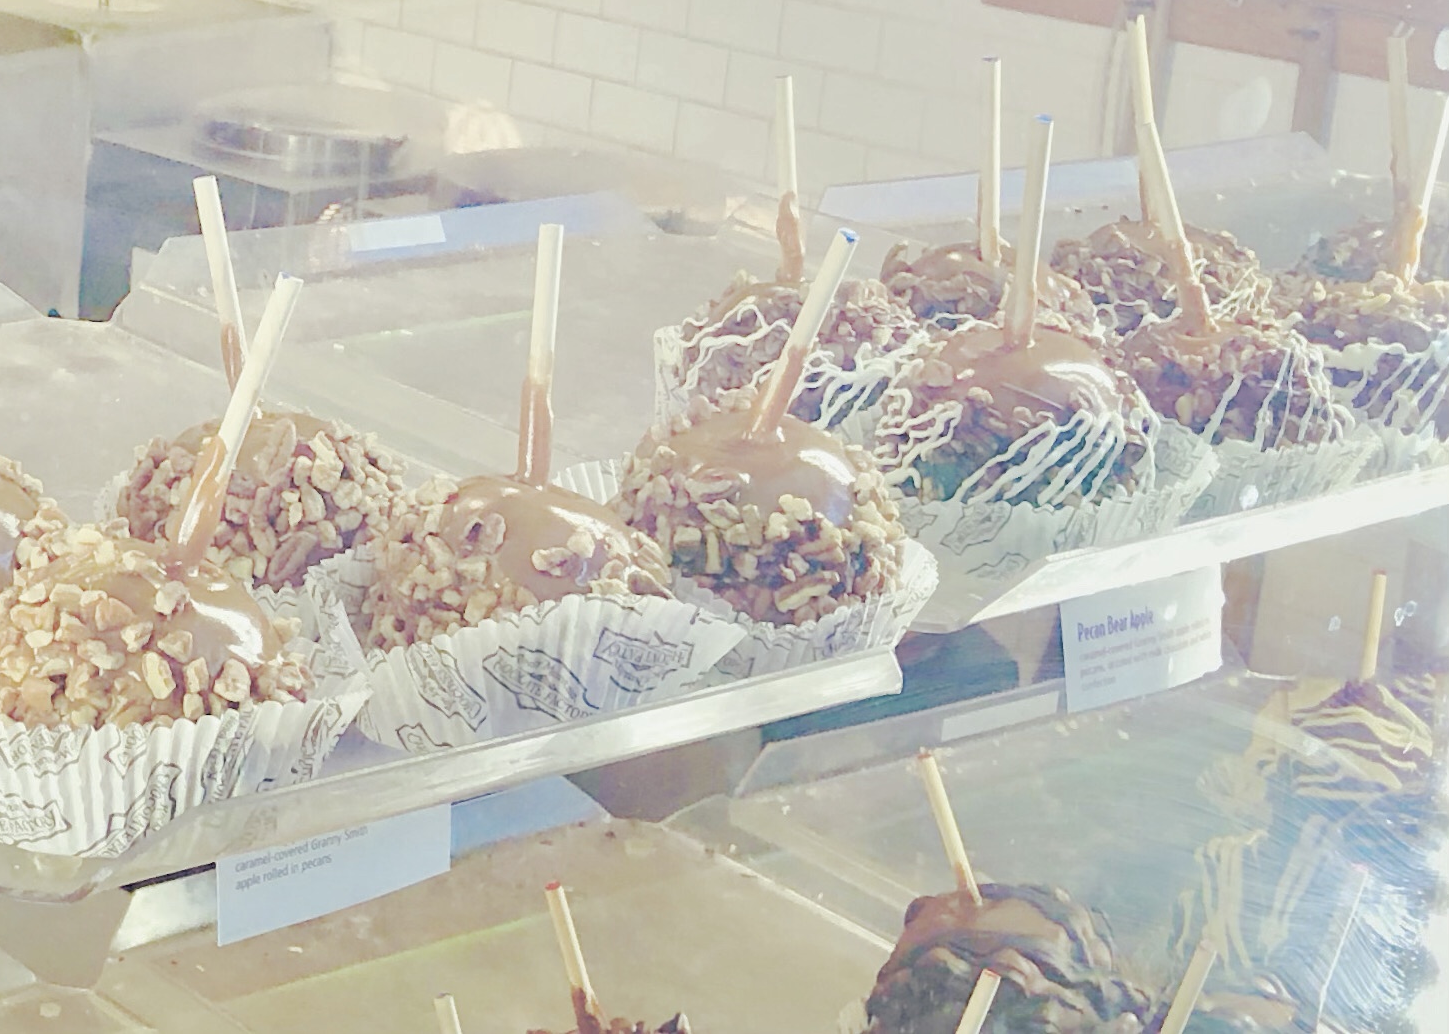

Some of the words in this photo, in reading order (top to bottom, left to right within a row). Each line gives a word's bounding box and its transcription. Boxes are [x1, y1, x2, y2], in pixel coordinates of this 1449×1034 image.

[1077, 622, 1106, 642] Pecan
[1107, 615, 1128, 635] Bear
[1130, 606, 1154, 631] Apple
[235, 841, 309, 872] caramel-covered
[311, 834, 342, 851] Granny
[235, 873, 261, 892] apple
[263, 864, 289, 882] rolled
[291, 863, 299, 874] in
[302, 853, 332, 873] pecans
